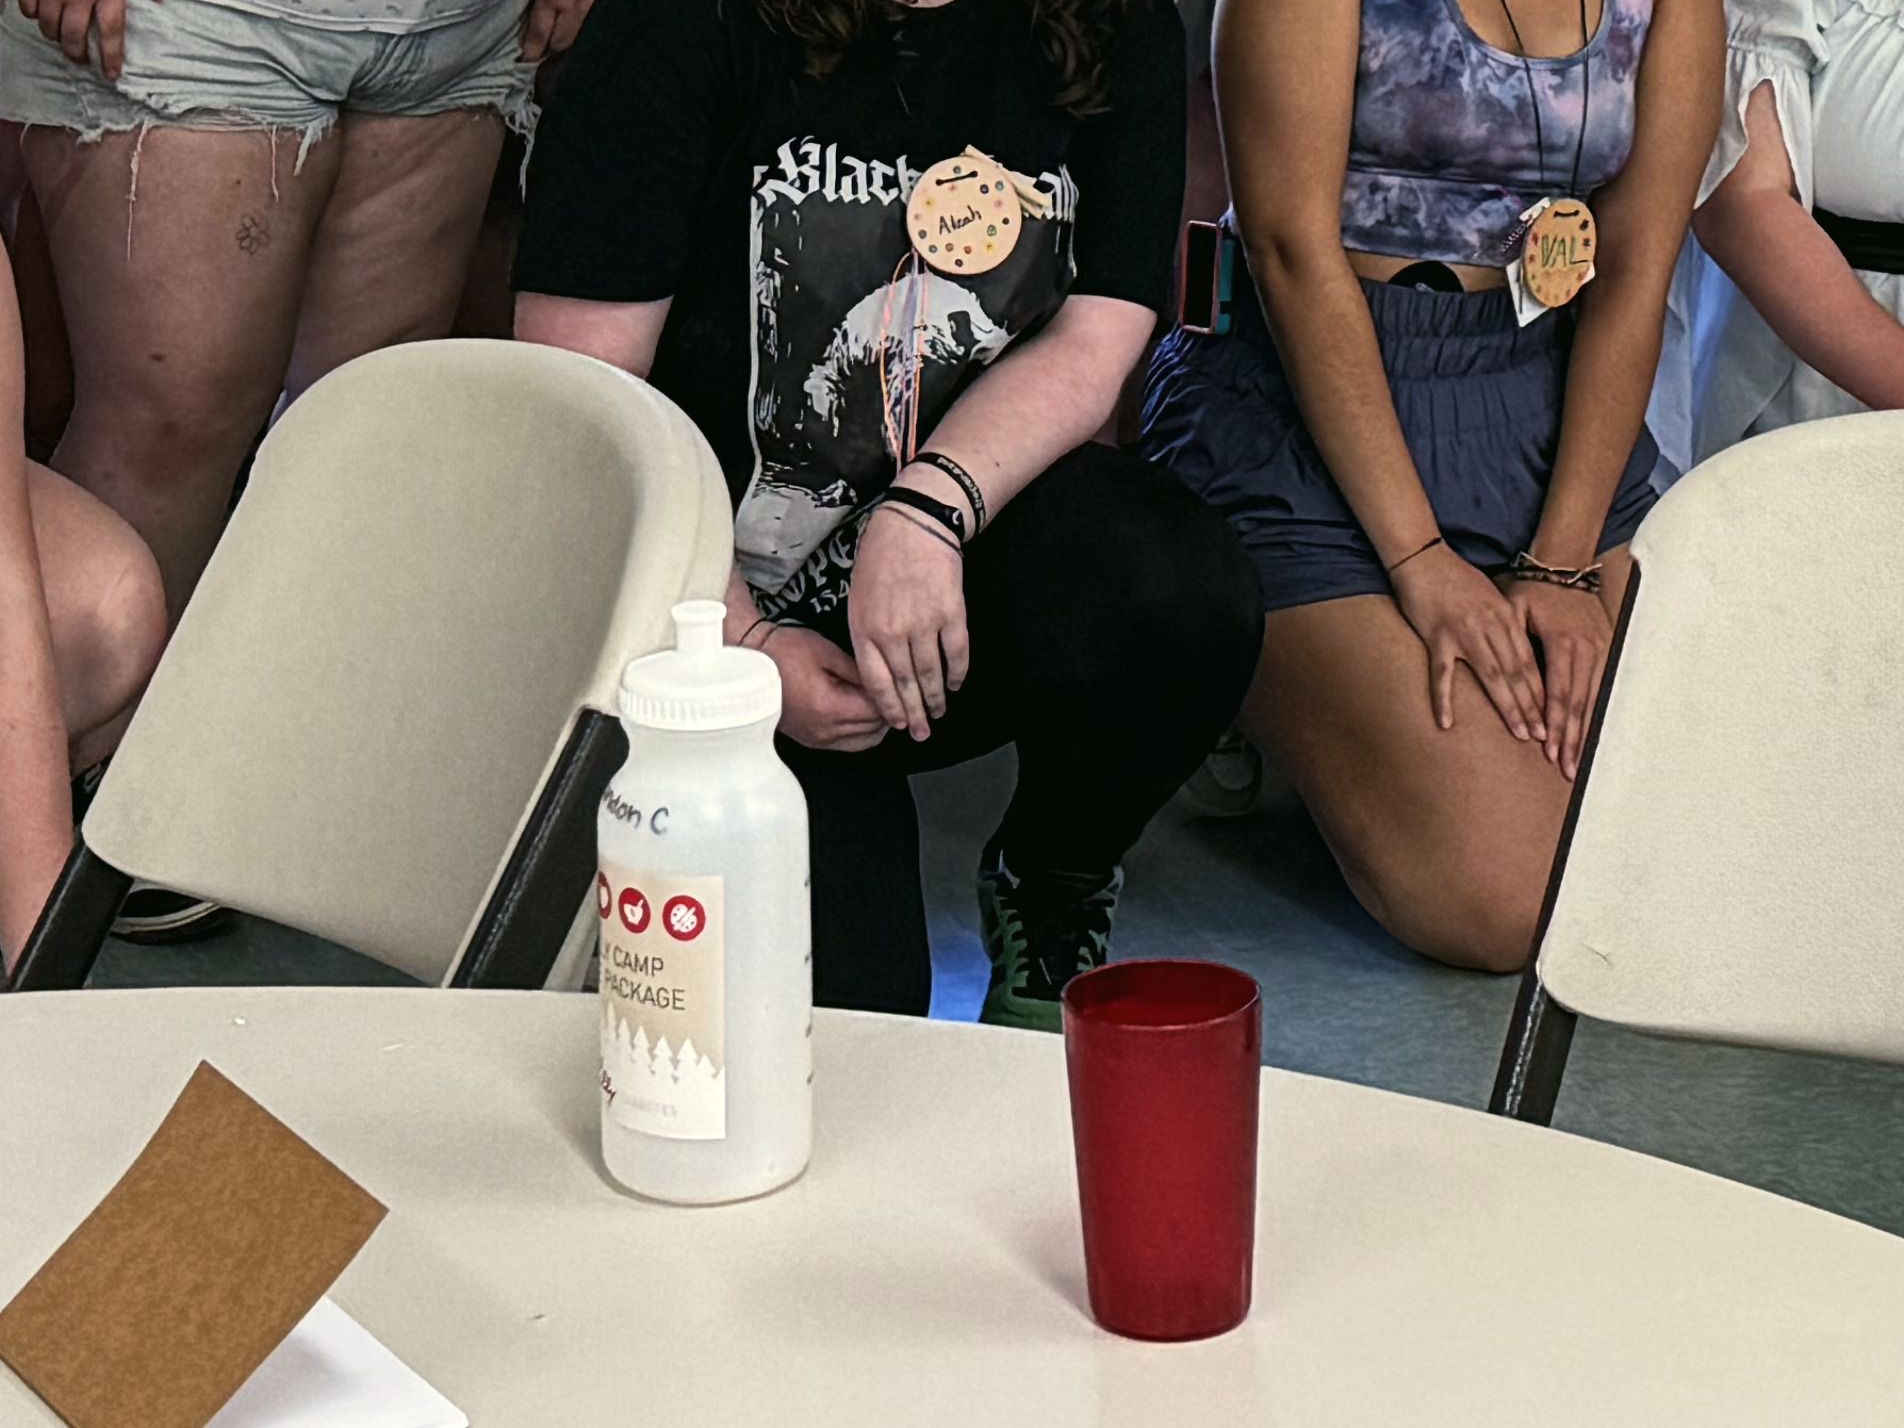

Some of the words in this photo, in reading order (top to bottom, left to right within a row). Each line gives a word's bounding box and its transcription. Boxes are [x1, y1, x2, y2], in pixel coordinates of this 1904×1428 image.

[1541, 233, 1594, 270] VAL
[601, 787, 642, 830] ndon
[612, 946, 665, 979] CAMP
[604, 976, 687, 1012] PACKAGE
